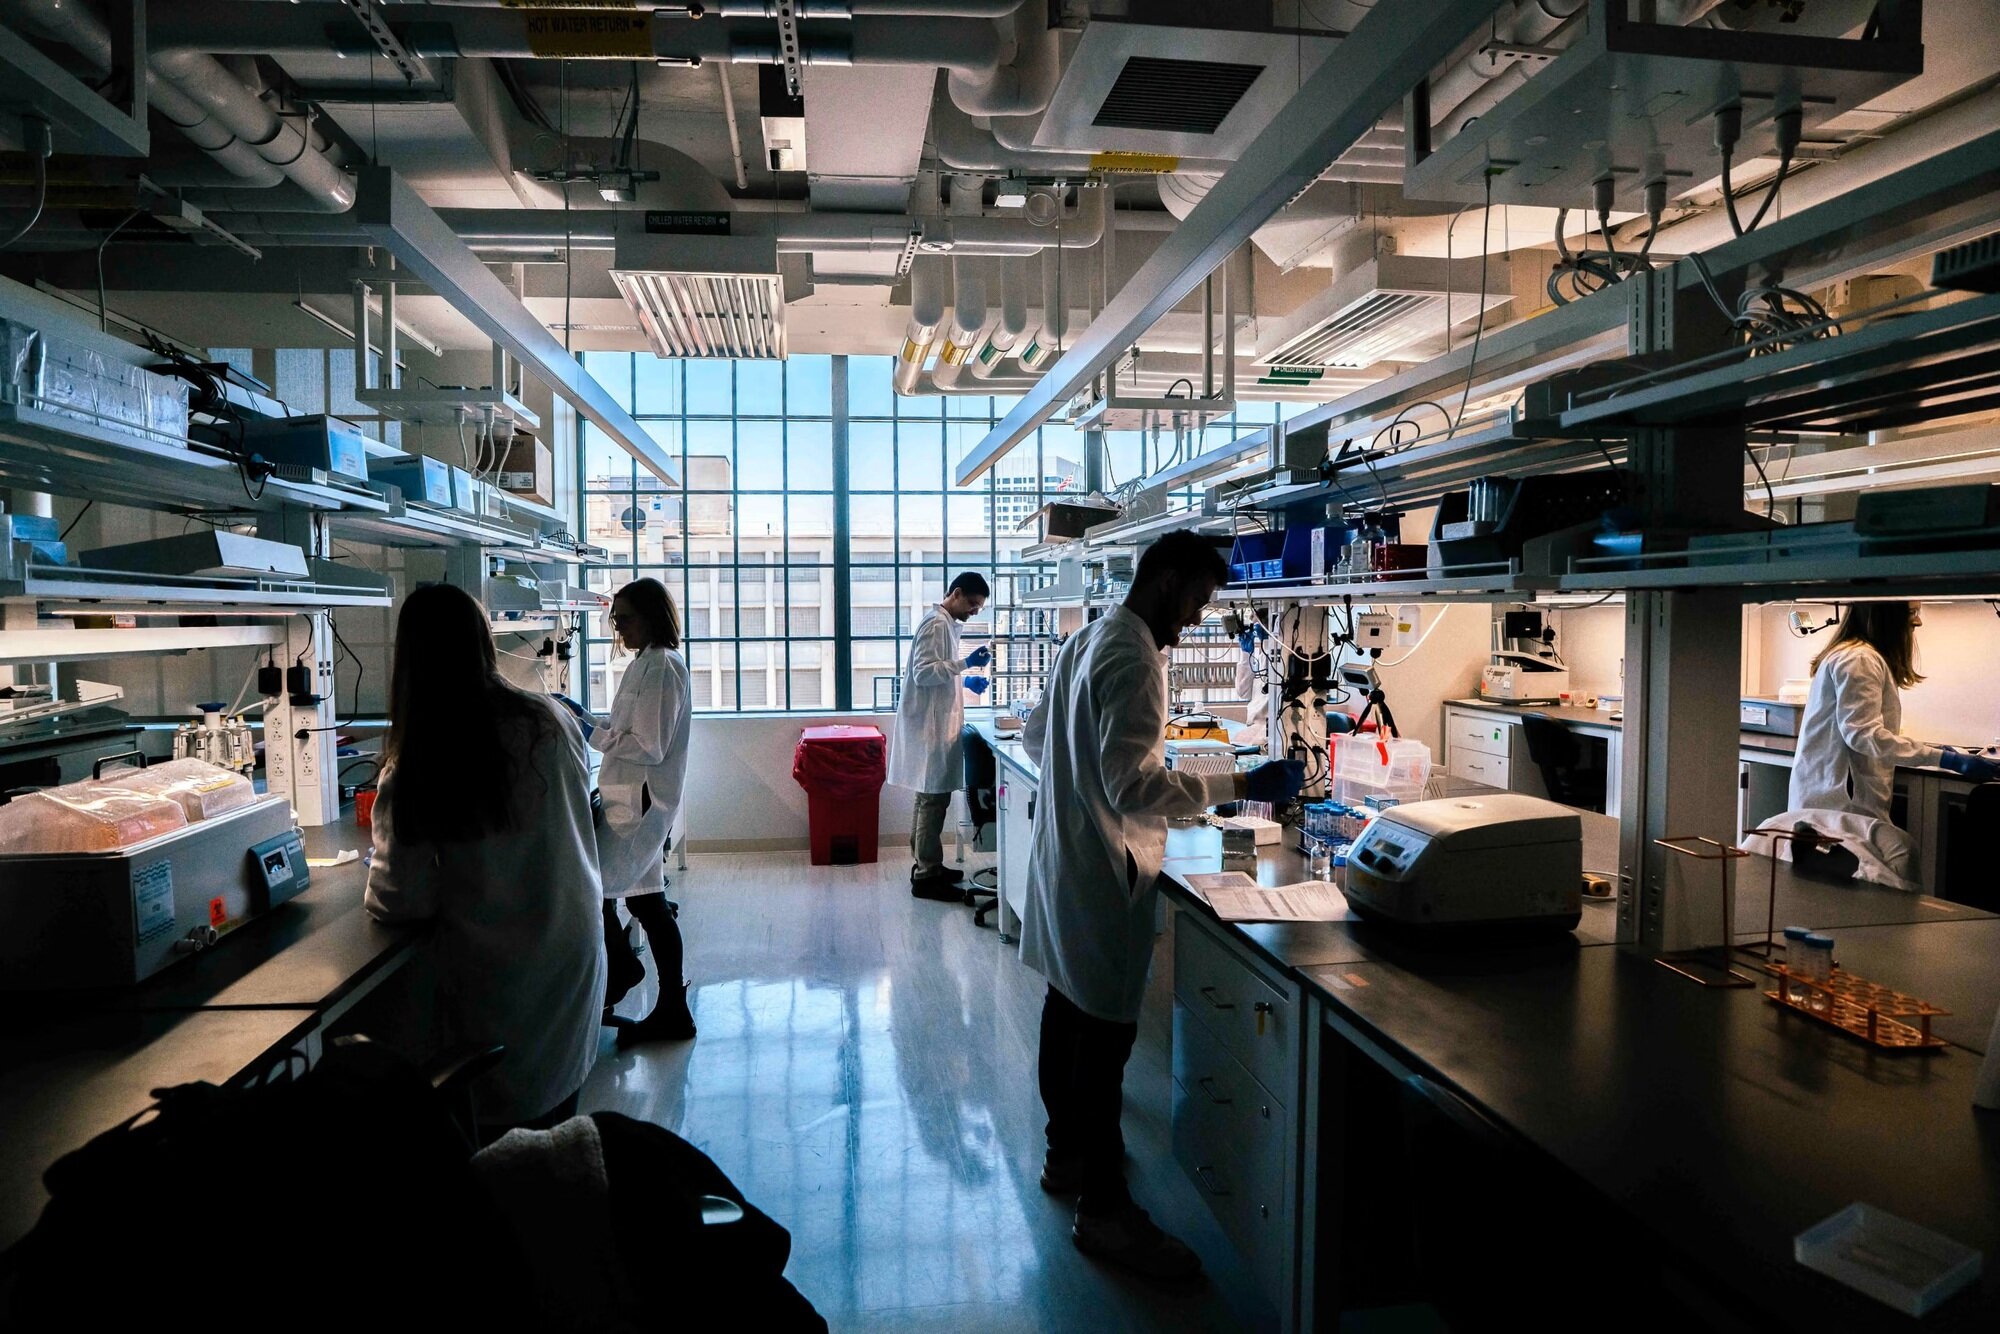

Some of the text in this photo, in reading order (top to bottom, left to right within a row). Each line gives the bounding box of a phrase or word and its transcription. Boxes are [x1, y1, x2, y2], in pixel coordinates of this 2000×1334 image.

[528, 16, 629, 32] HOT WATER RETURN
[648, 215, 717, 225] CHILLED WATER RETURN
